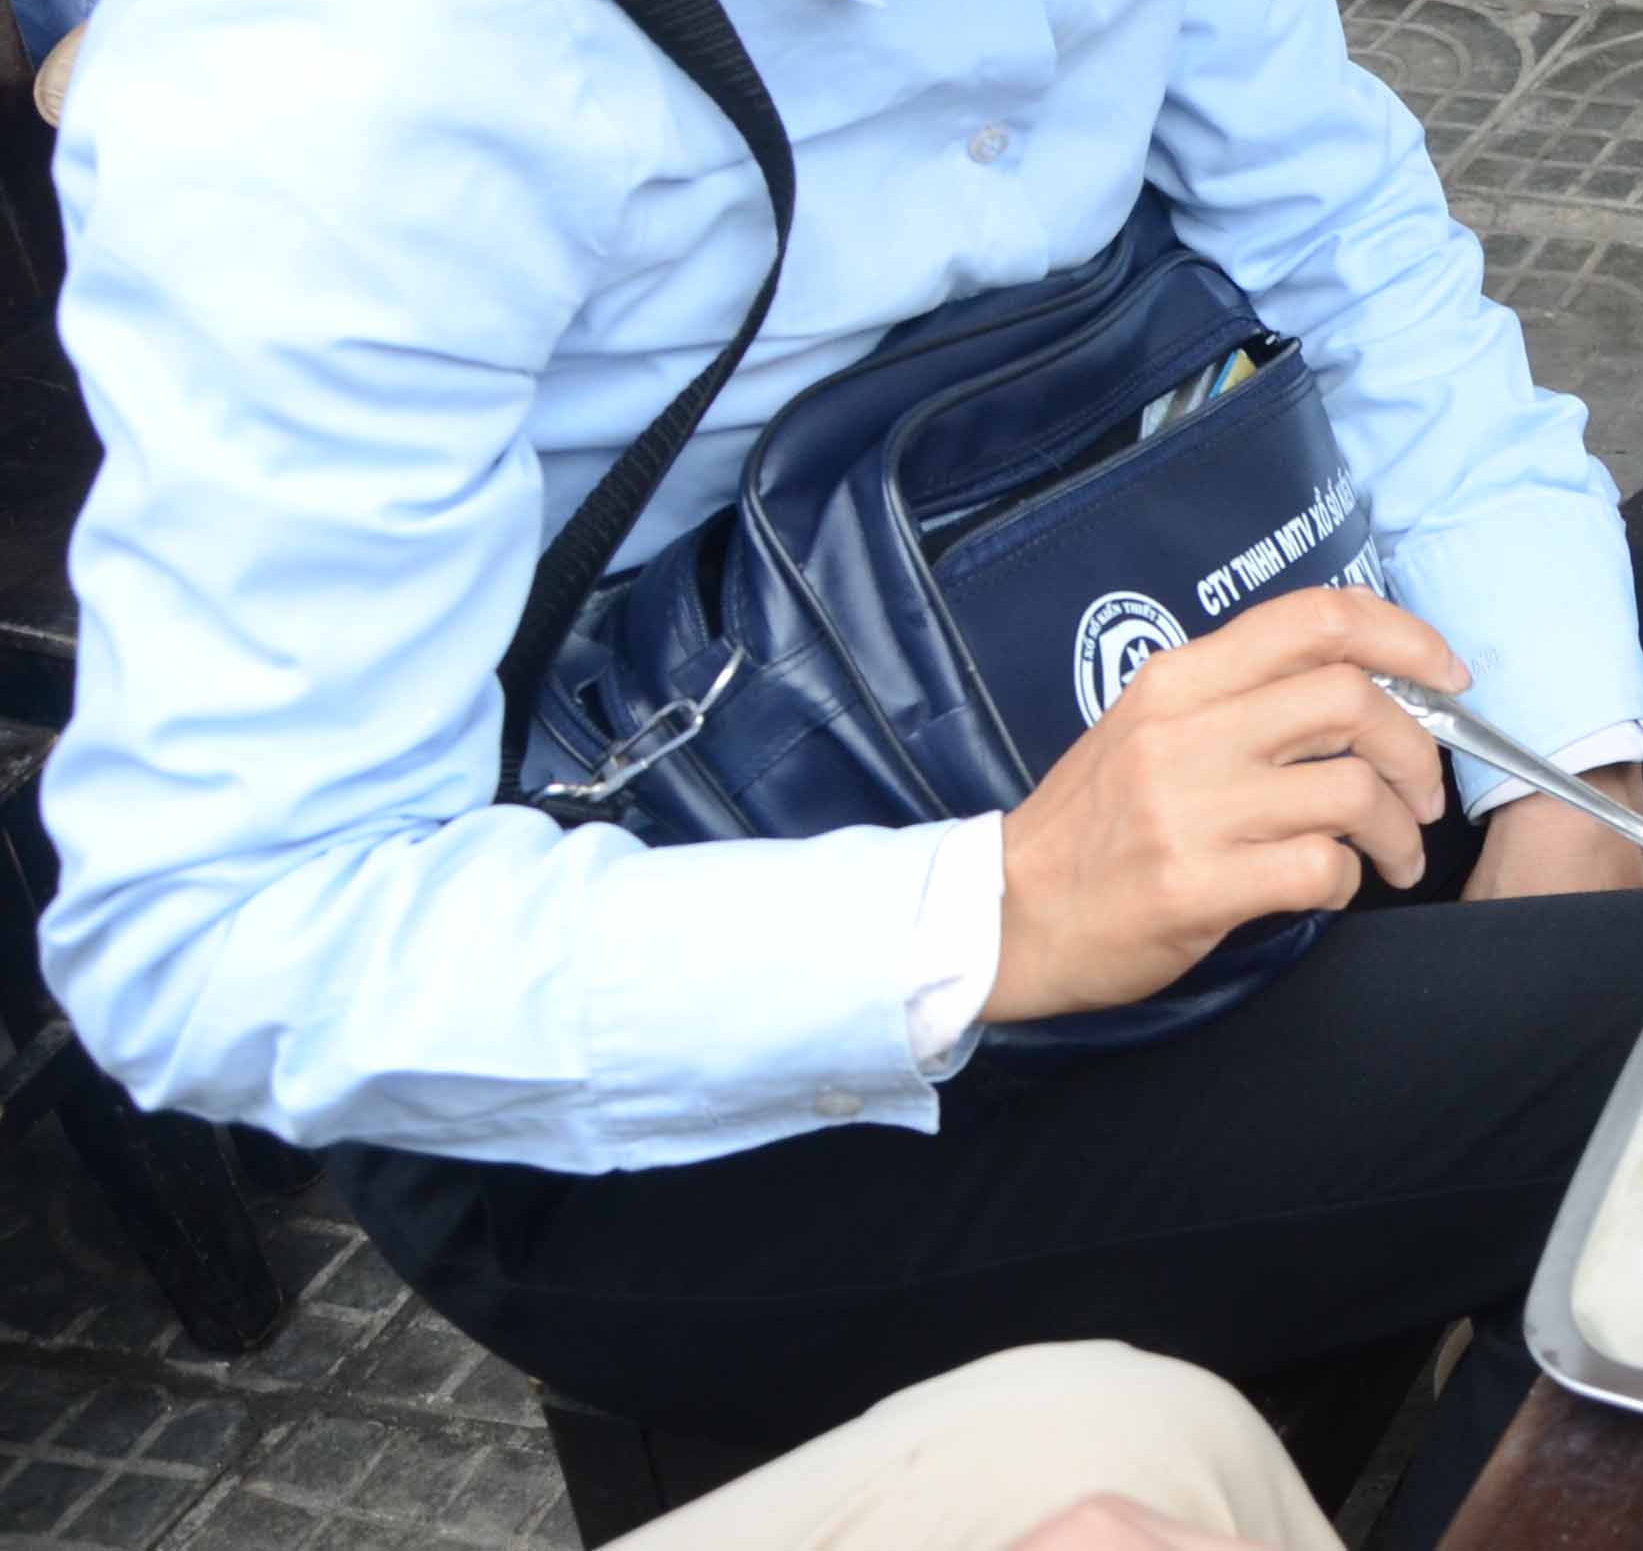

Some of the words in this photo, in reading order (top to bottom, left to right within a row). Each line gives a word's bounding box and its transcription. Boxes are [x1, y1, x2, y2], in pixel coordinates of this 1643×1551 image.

[1197, 564, 1241, 616] CTY
[1230, 536, 1286, 591] TNHH
[1274, 512, 1316, 563] MTV
